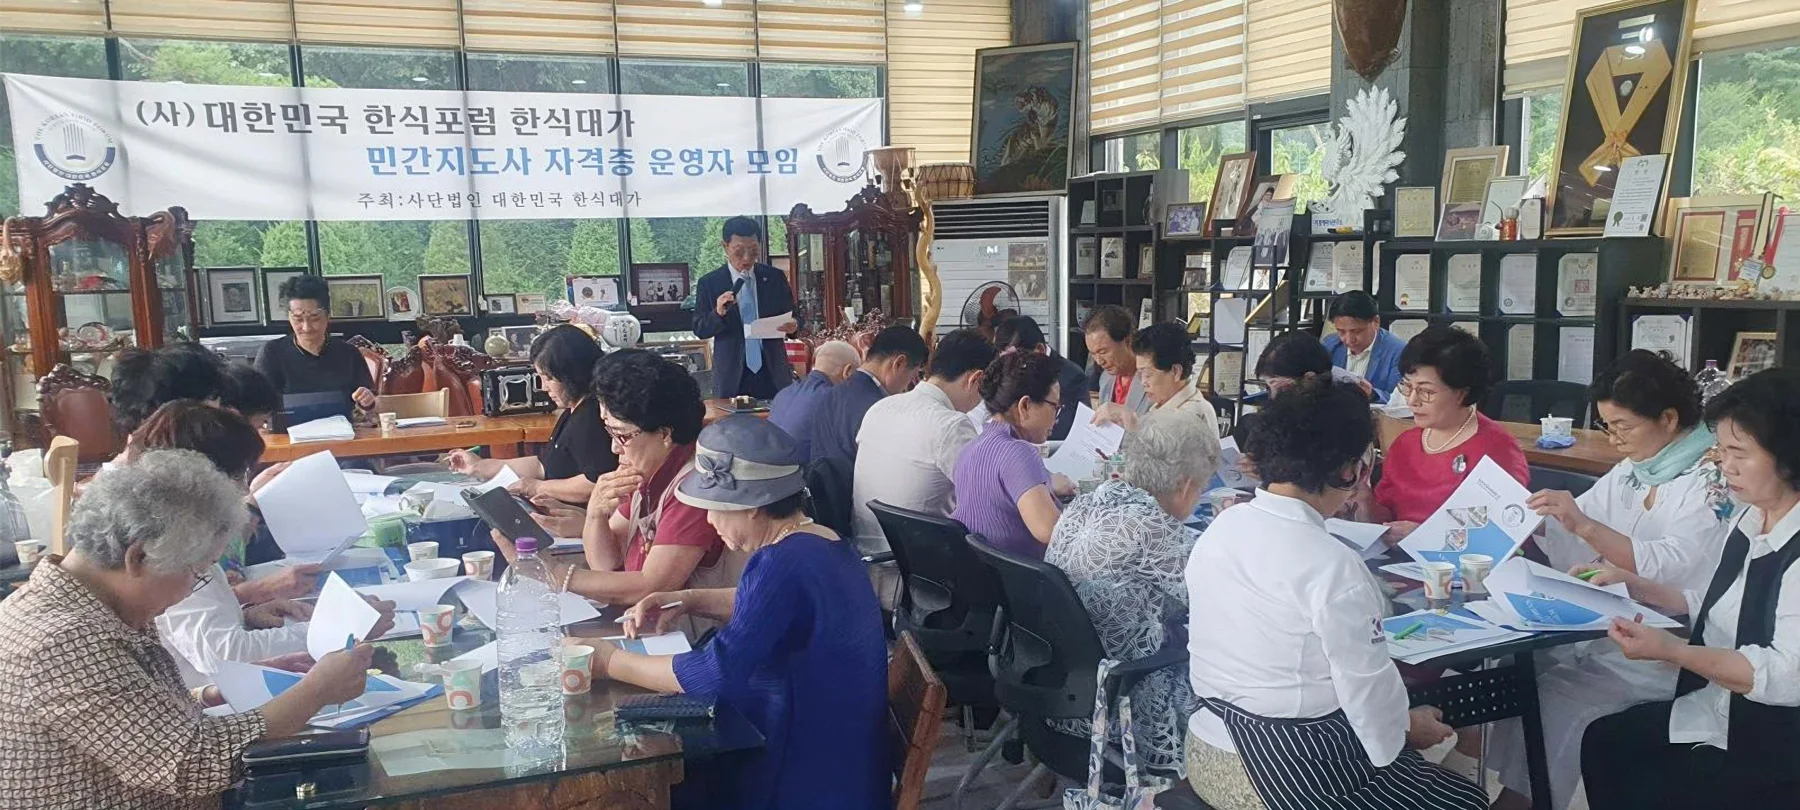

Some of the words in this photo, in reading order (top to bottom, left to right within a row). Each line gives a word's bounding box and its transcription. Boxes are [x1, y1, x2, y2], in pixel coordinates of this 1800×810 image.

[363, 104, 497, 136] 한식포럼
[509, 108, 636, 138] 한식대가
[366, 145, 532, 176] 민간지도사
[544, 147, 636, 177] 자격증
[648, 148, 735, 176] 운영자
[746, 148, 800, 175] 모임
[491, 191, 564, 209] 대한민국
[571, 191, 643, 208] 한식대가
